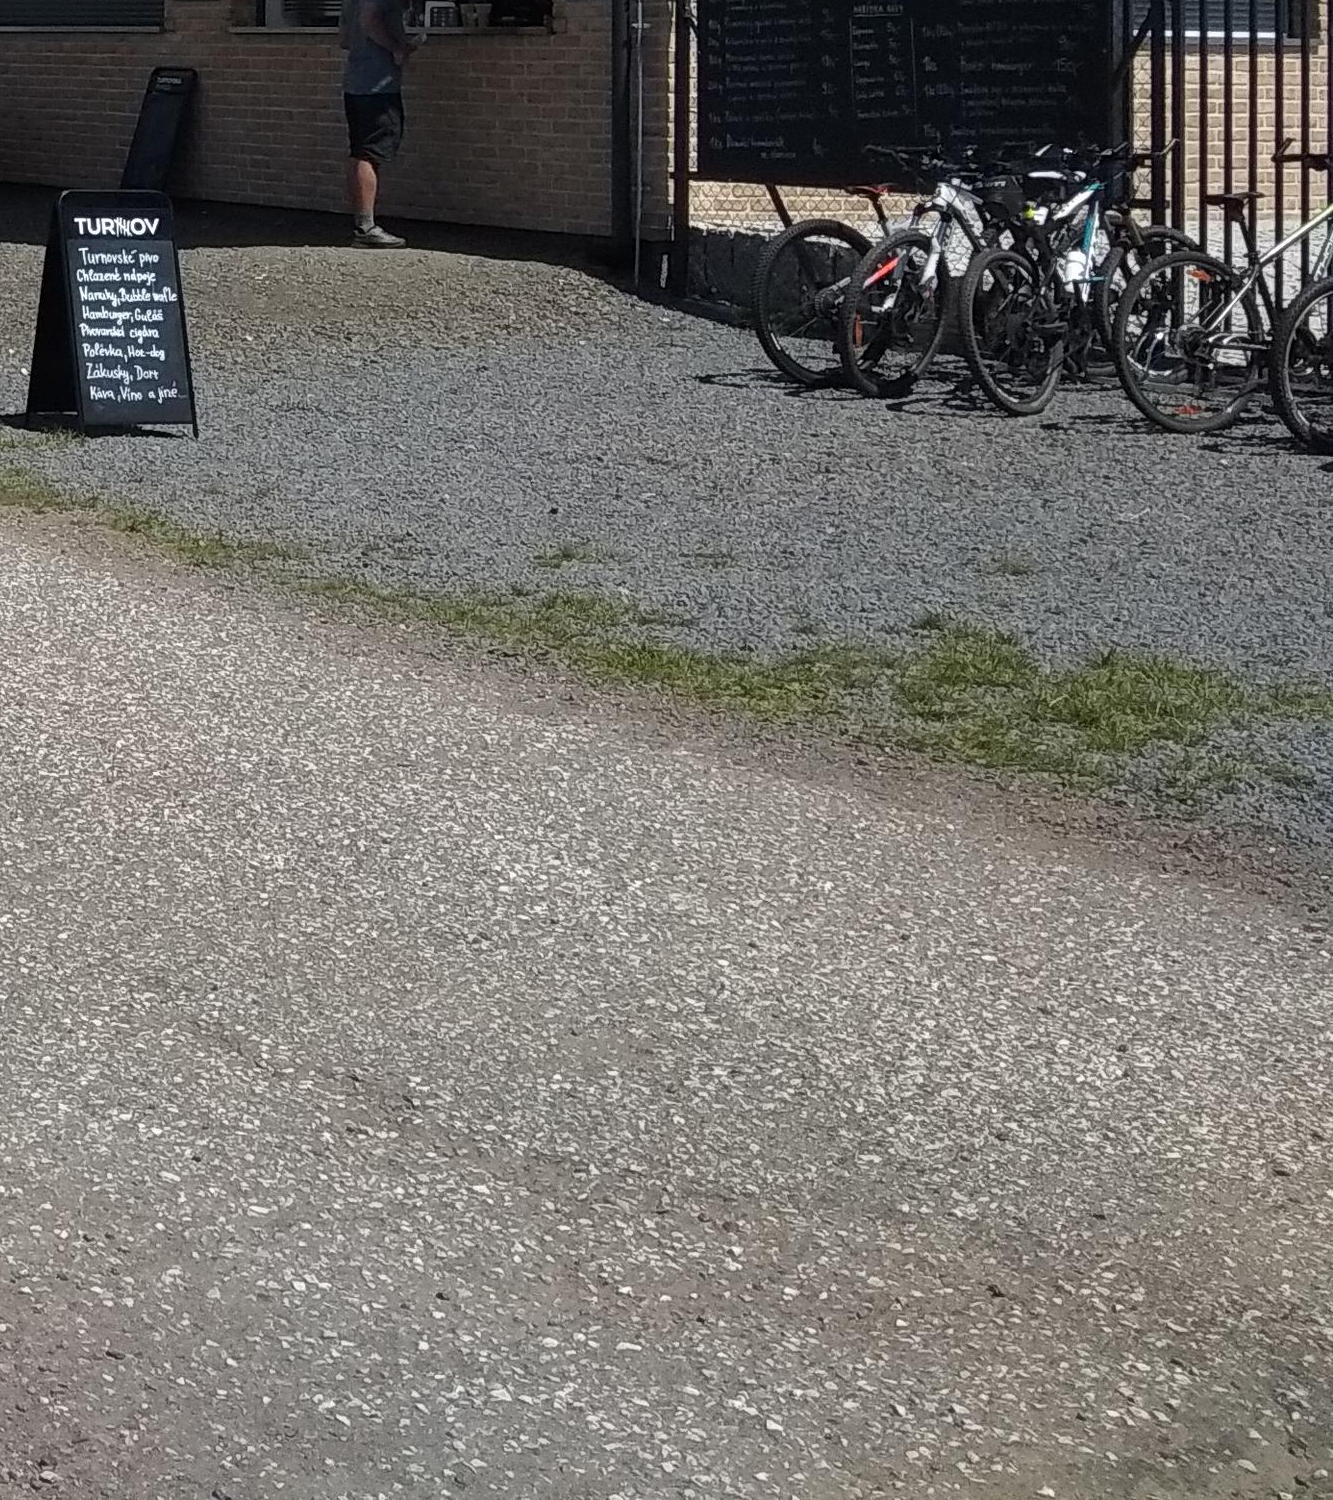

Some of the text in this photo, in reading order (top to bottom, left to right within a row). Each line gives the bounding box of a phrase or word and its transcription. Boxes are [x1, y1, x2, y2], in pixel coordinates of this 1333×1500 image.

[74, 216, 160, 238] TURNOV
[78, 247, 160, 268] Turnovské pivo
[76, 267, 156, 286] Chlazené nápoje
[129, 325, 160, 344] cigára
[133, 364, 159, 380] Dort
[148, 391, 156, 399] a
